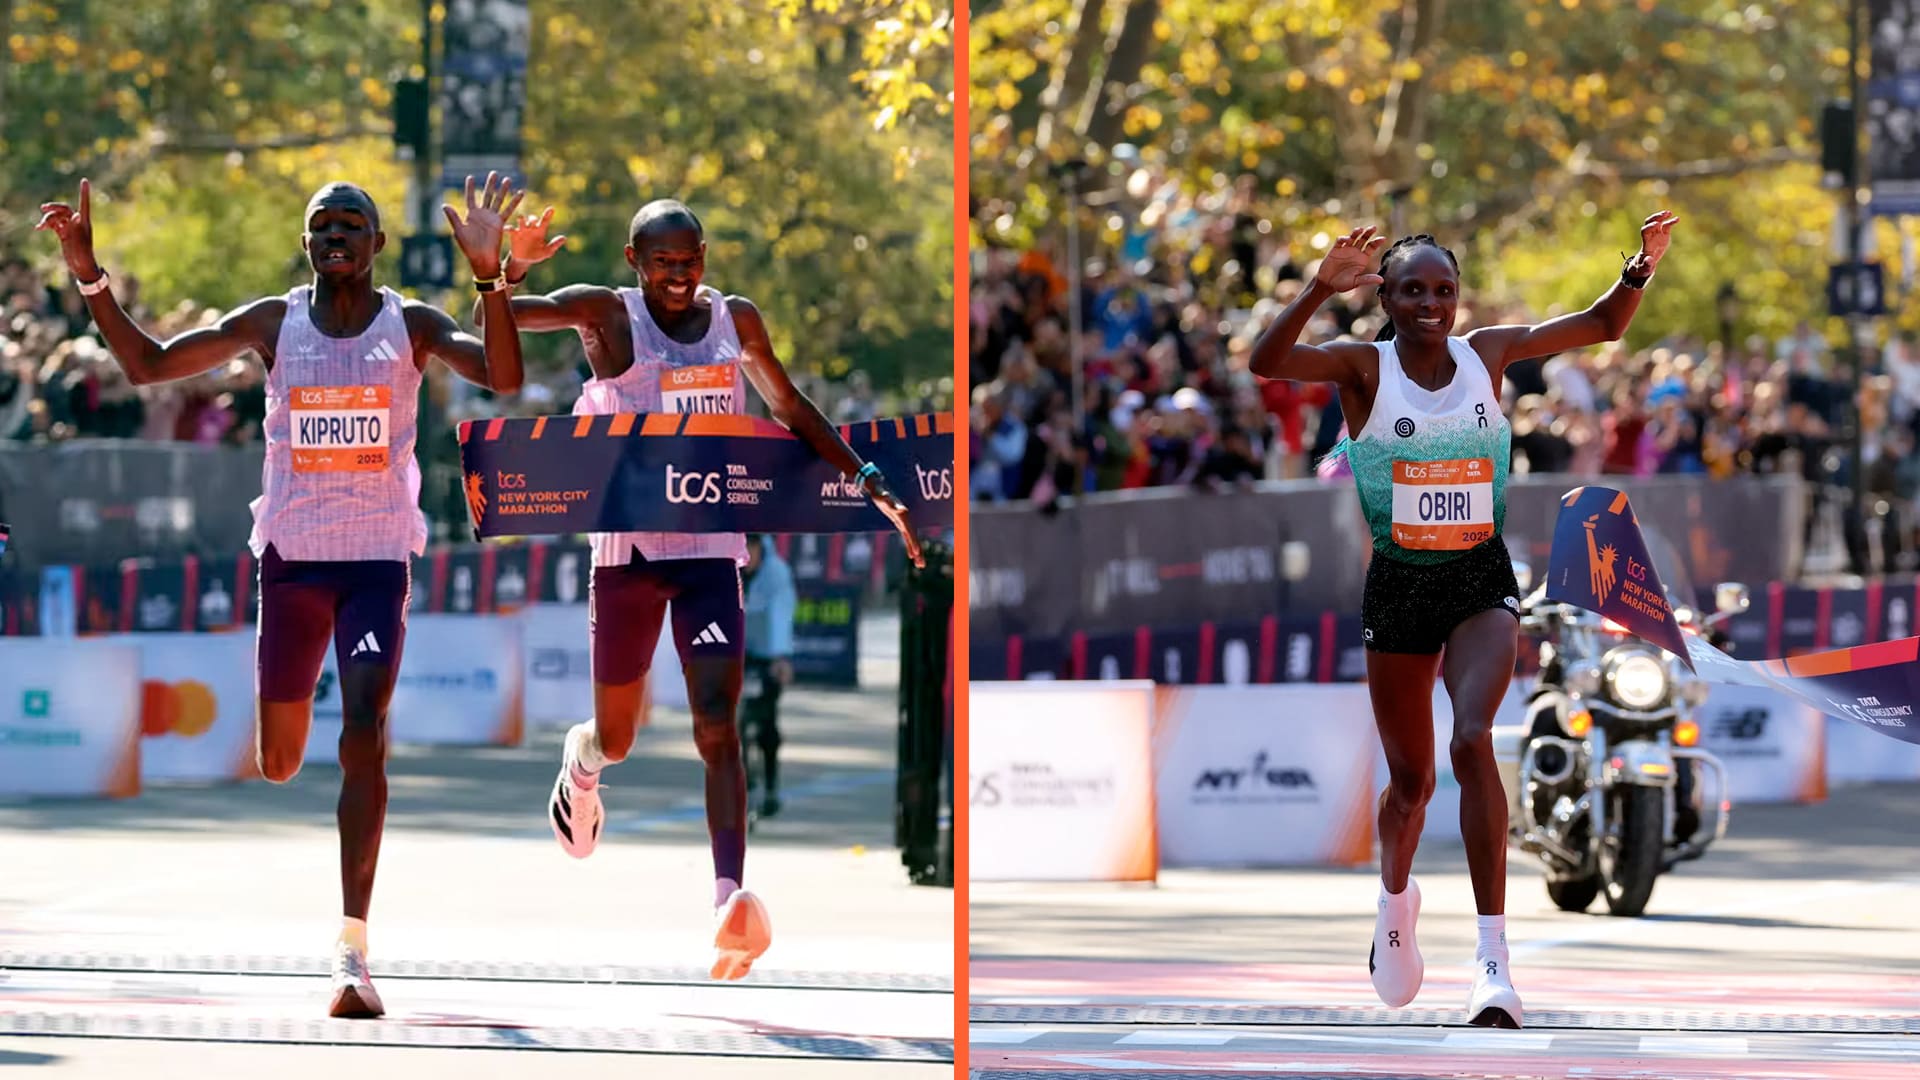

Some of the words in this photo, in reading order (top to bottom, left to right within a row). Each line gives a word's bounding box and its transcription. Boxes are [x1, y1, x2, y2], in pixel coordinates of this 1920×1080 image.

[671, 371, 695, 384] tcs
[301, 391, 322, 404] tcs
[299, 416, 381, 445] KIPRUTO
[357, 454, 384, 464] 2025
[726, 464, 747, 475] TATA
[1405, 463, 1427, 478] tcs
[497, 470, 526, 488] tcs
[665, 463, 721, 504] tcs
[726, 478, 773, 491] CONSULTANCY
[916, 463, 952, 500] tcs
[498, 492, 525, 503] NEW
[528, 492, 561, 502] YORK
[562, 490, 589, 501] CITY
[726, 492, 759, 505] SERVICES
[498, 503, 568, 515] MARATHON
[1418, 492, 1471, 521] OBIRI
[1462, 531, 1489, 542] 2025
[1627, 556, 1647, 581] tcs
[1623, 579, 1643, 597] NEW
[1643, 589, 1663, 608] YORK
[1620, 592, 1665, 622] MARATHON
[1857, 696, 1881, 706] TATA
[1866, 705, 1912, 717] CONSULTANCY
